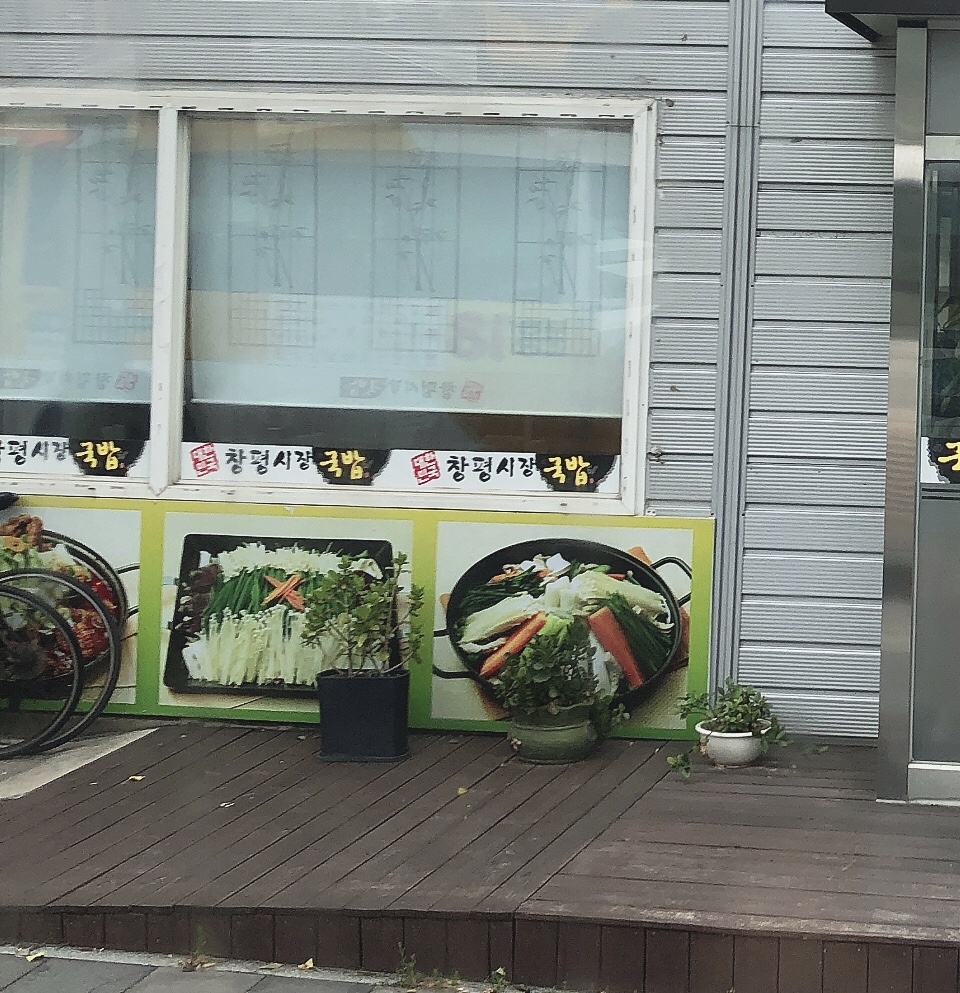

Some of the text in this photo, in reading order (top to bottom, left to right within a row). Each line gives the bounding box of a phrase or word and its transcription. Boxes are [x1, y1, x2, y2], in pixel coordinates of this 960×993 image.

[0, 440, 121, 471] 평시장 국밥
[224, 448, 313, 475] 창평시장
[319, 449, 365, 480] 국밥
[446, 455, 536, 483] 창평시장
[543, 455, 590, 486] 국밥
